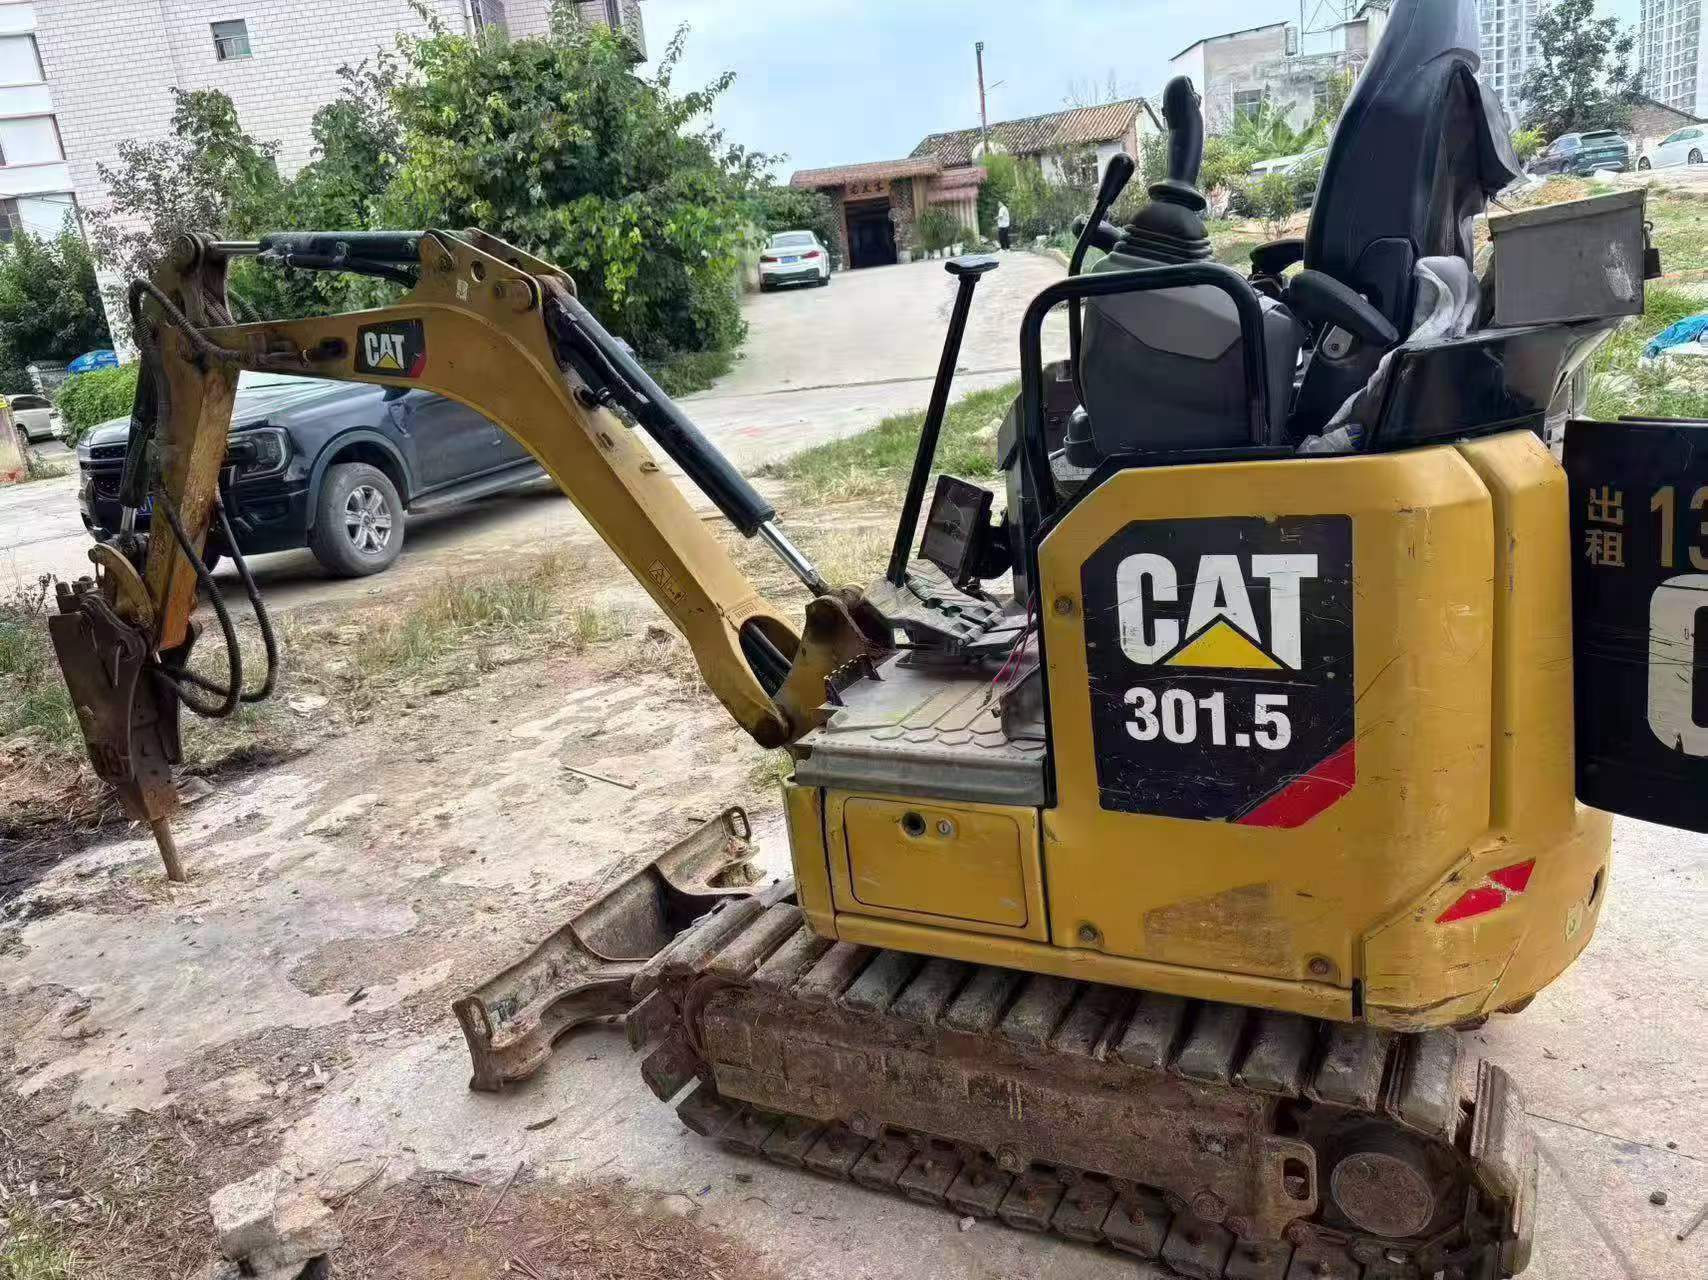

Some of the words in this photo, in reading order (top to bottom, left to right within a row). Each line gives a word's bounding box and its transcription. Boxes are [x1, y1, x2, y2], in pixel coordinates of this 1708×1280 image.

[364, 331, 405, 369] CAT
[1585, 485, 1624, 567] 出租
[1116, 553, 1318, 670] CAT
[1124, 687, 1291, 750] 301.5
